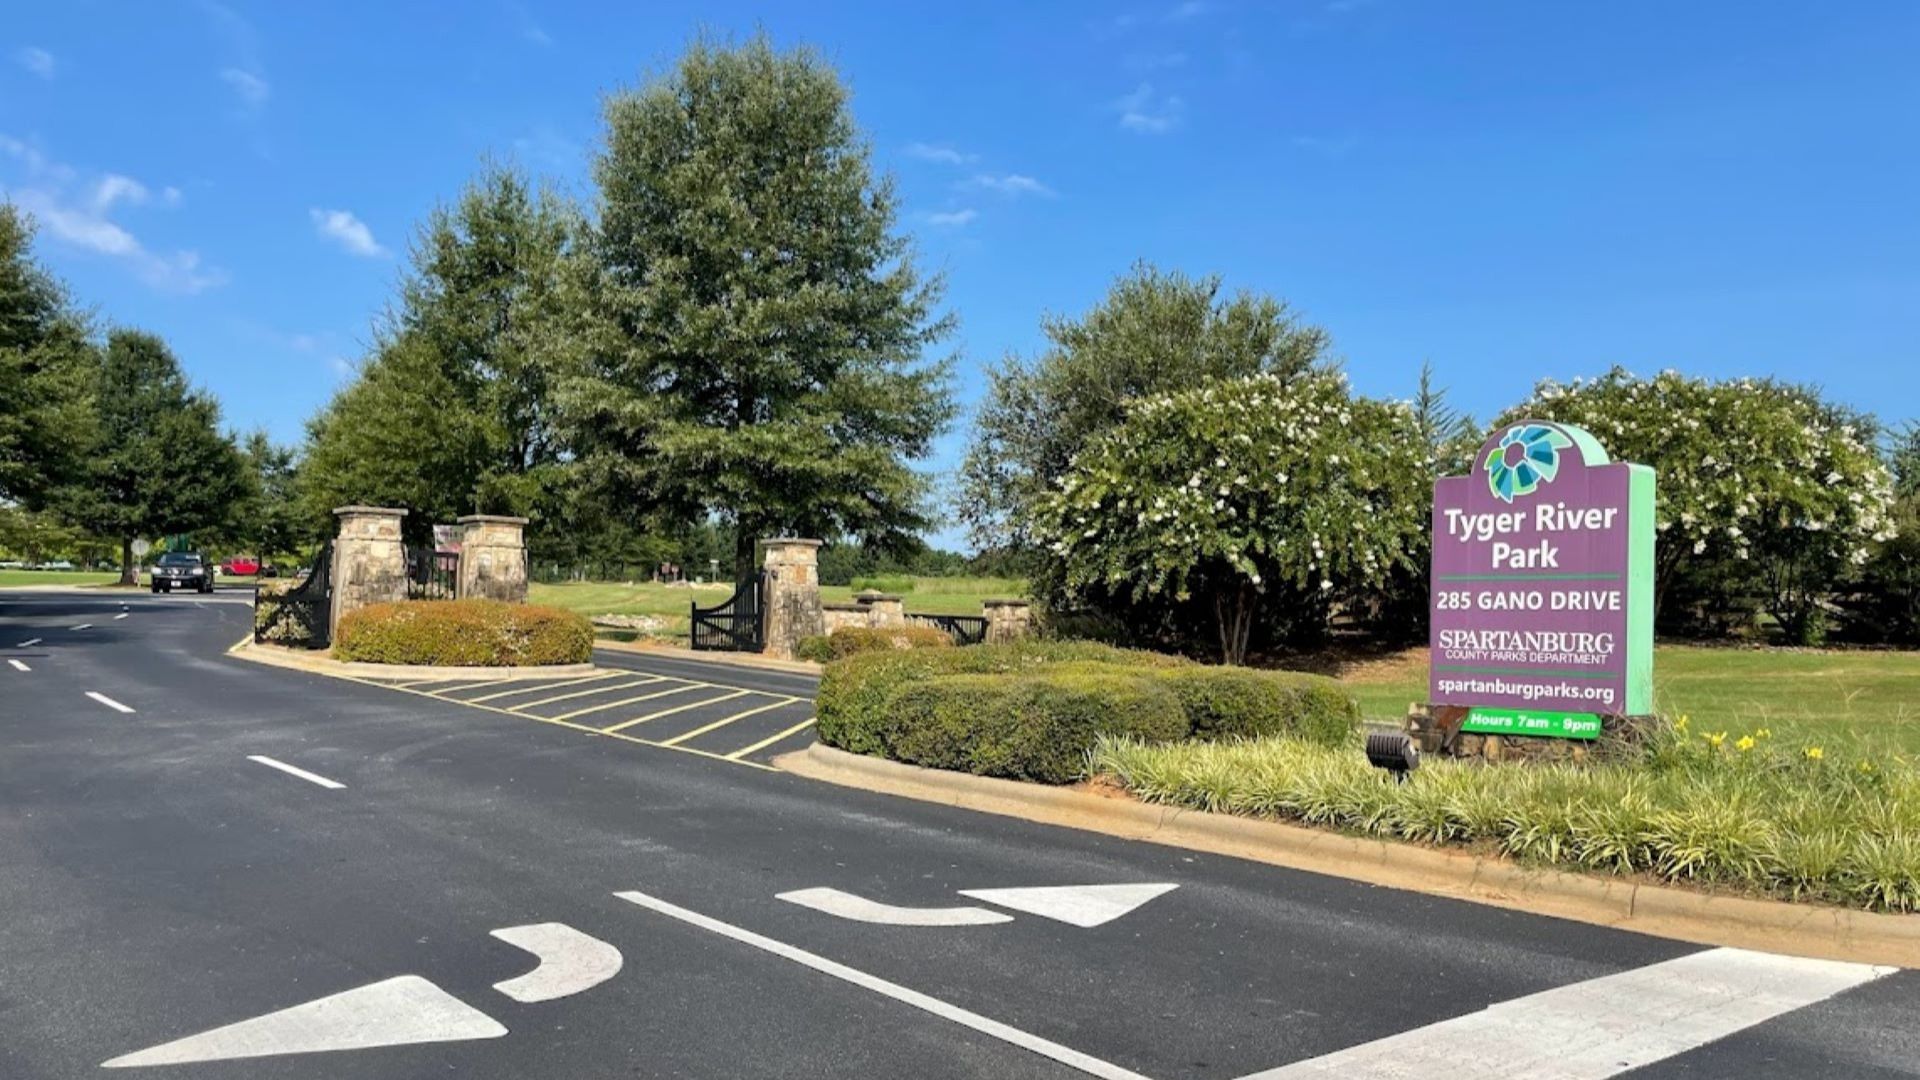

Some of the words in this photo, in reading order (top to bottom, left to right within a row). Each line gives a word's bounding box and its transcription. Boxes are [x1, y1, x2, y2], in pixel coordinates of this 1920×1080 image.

[1444, 509, 1526, 541] Tyger
[1535, 502, 1618, 531] River
[1492, 540, 1559, 569] Park
[1437, 591, 1471, 610] 285
[1477, 591, 1544, 611] GANO
[1550, 591, 1621, 611] DRIVE
[1439, 630, 1615, 653] SPARTANBURG
[1445, 650, 1489, 660] COUNTY
[1490, 651, 1527, 663] PARKS
[1529, 652, 1608, 665] DEPARTMENT
[1438, 679, 1615, 704] spartanburgparks.org
[1470, 713, 1512, 726] Hours
[1518, 715, 1549, 729] 7am
[1562, 716, 1597, 733] 9pm
